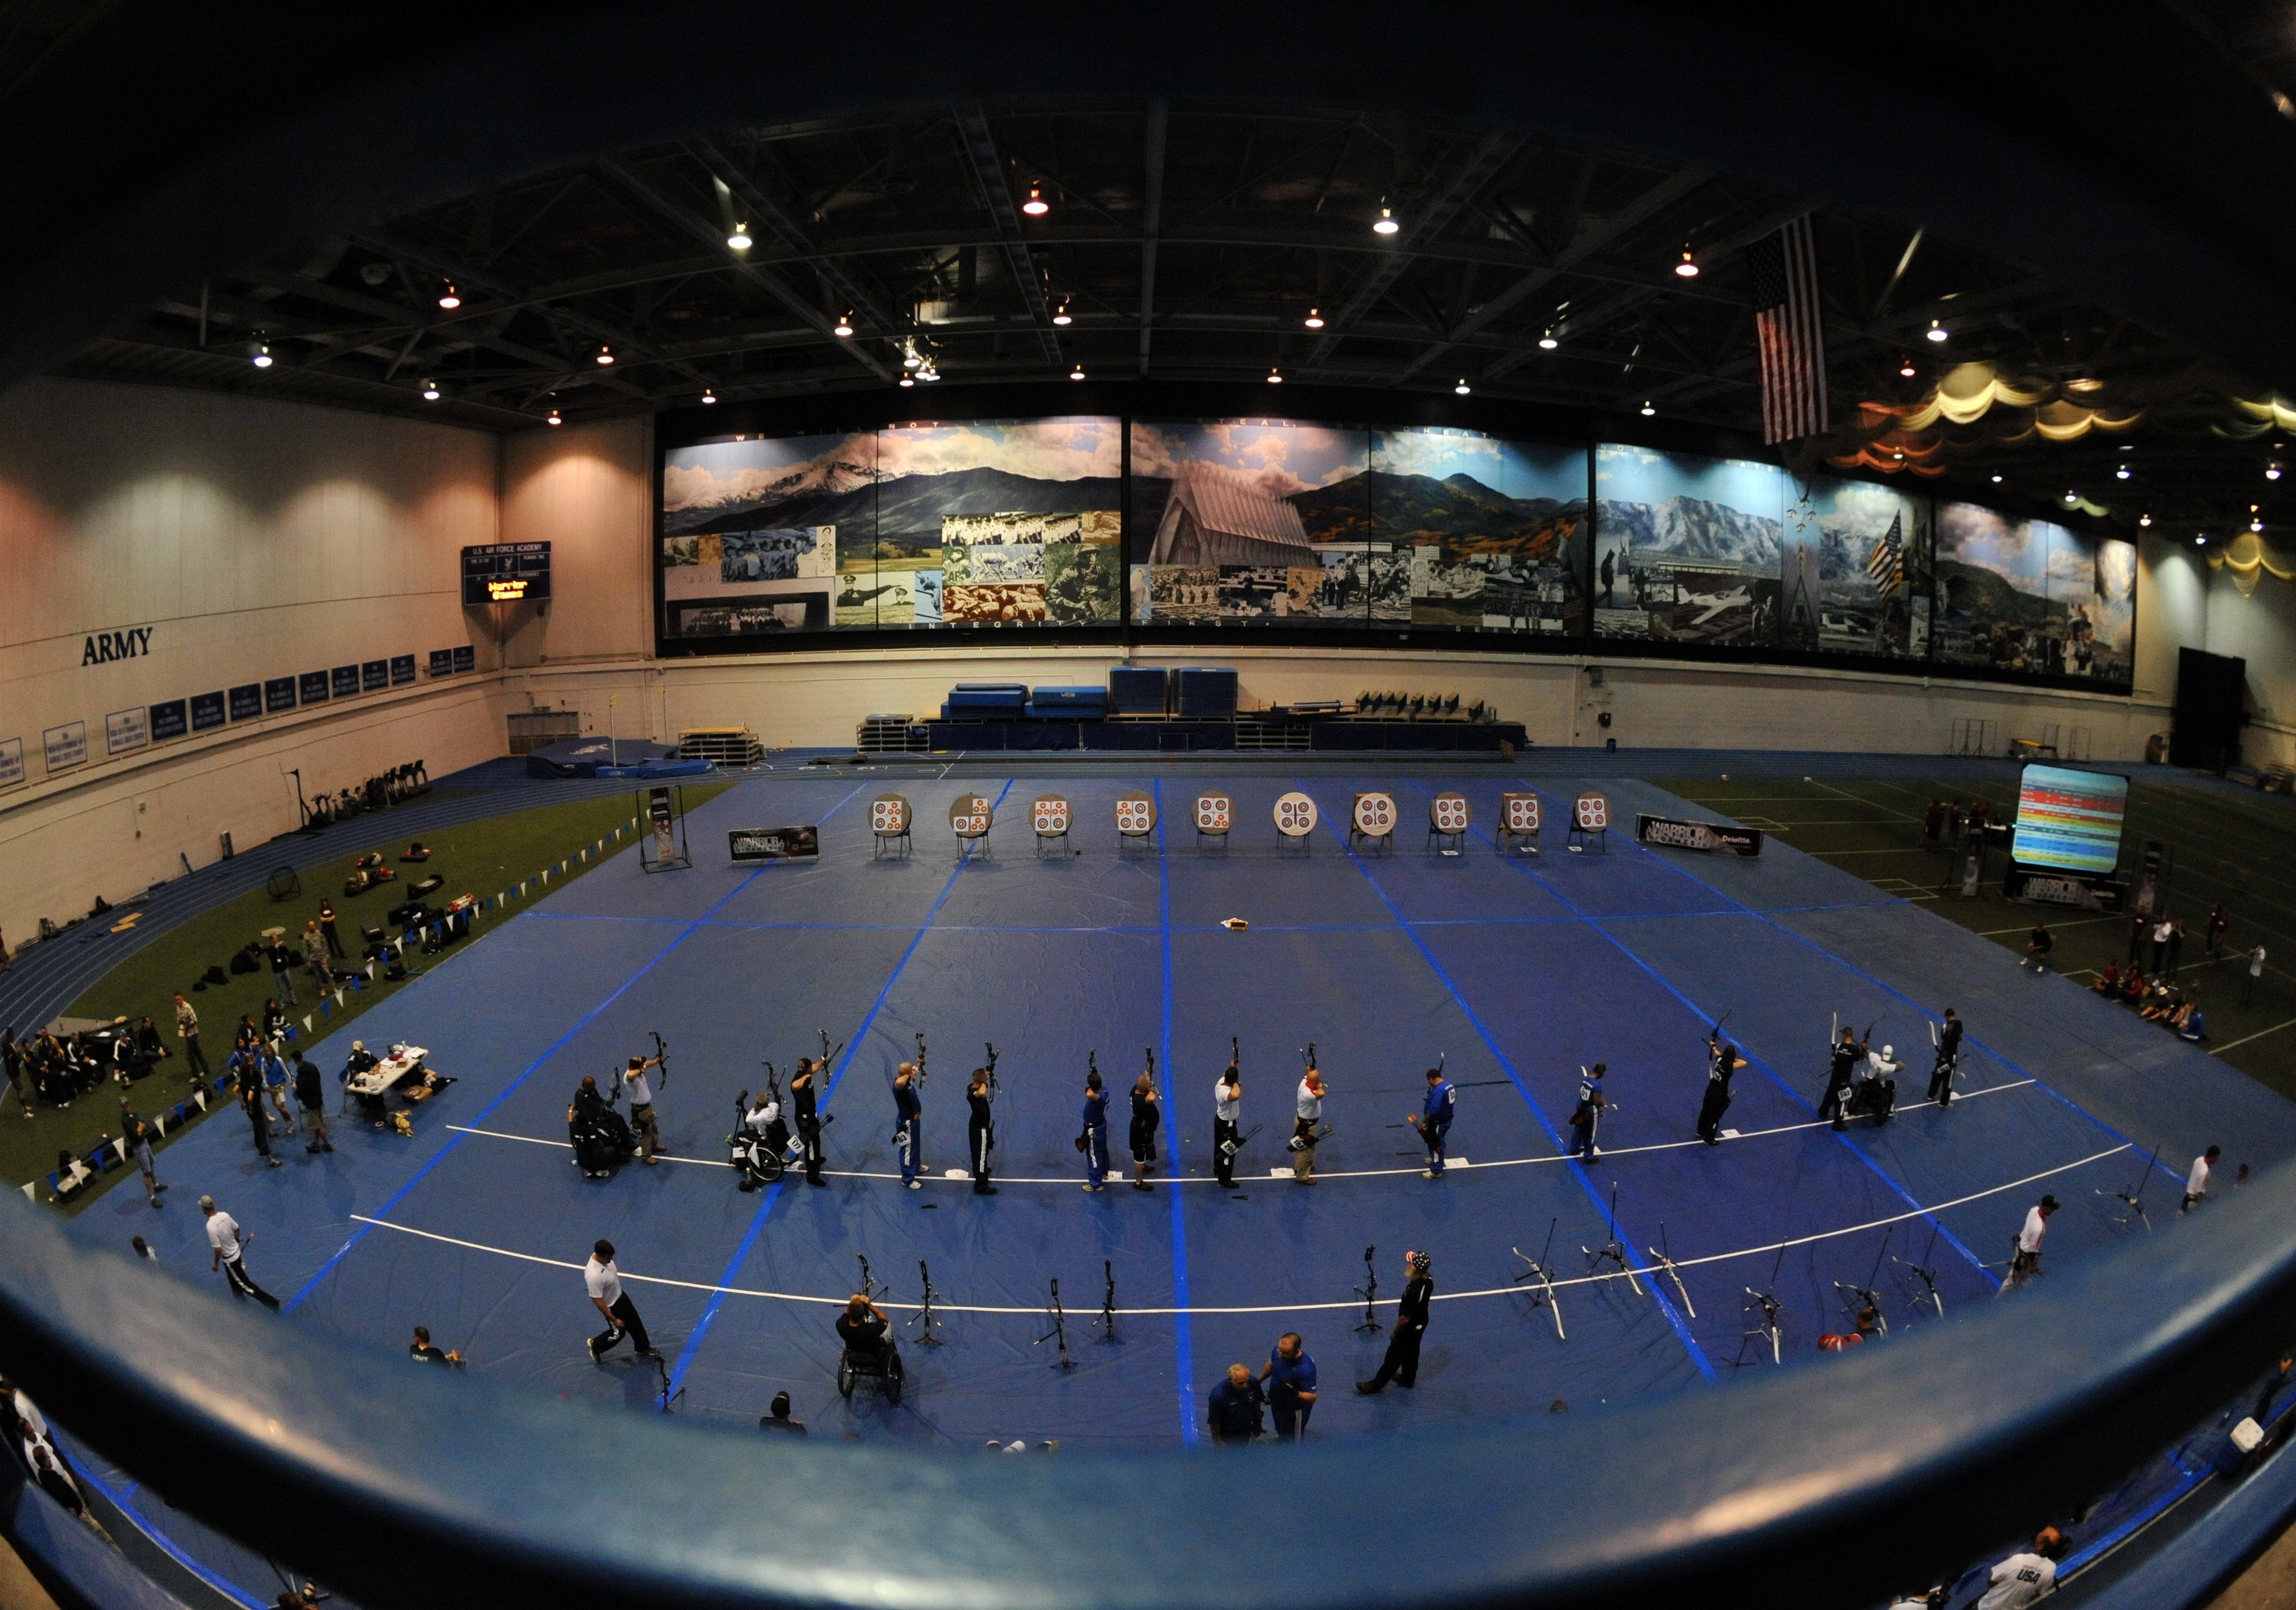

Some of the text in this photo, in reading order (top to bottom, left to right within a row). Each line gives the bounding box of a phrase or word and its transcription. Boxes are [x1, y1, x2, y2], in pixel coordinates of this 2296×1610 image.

[735, 433, 764, 442] WE
[488, 580, 528, 592] Warrior
[908, 620, 1087, 630] INTEGRITY
[1456, 625, 1569, 637] SERVICE
[82, 627, 152, 666] ARMY
[1652, 821, 1705, 841] WARRIOR
[736, 836, 778, 848] WARRIOR
[1661, 836, 1695, 846] GAMES
[2029, 877, 2078, 895] WARRIOR
[2017, 1569, 2041, 1585] USA
